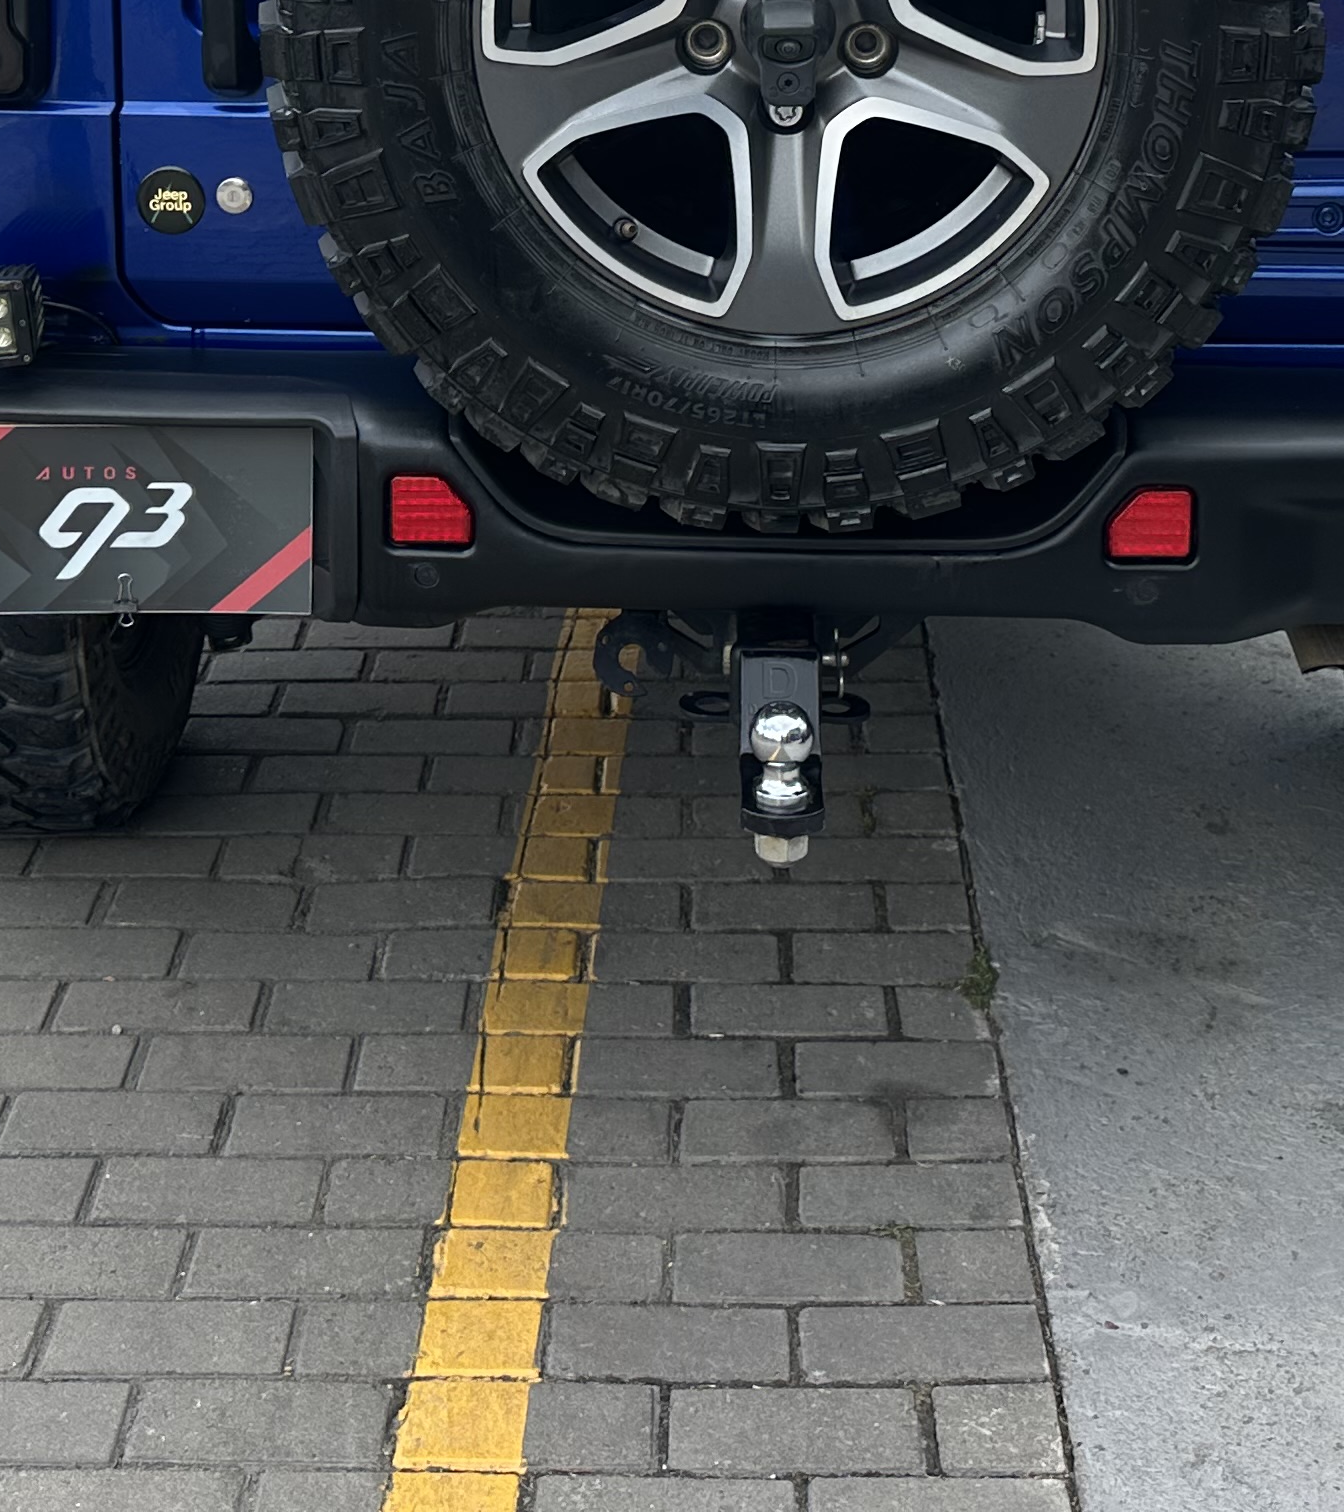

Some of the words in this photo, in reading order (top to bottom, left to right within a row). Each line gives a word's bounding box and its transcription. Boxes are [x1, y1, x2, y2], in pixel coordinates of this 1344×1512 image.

[379, 31, 458, 205] BAJA
[149, 199, 192, 214] Group
[153, 188, 188, 209] Jeep
[994, 38, 1203, 378] THOMPSON
[35, 465, 137, 481] AUTOS
[39, 481, 194, 580] 93
